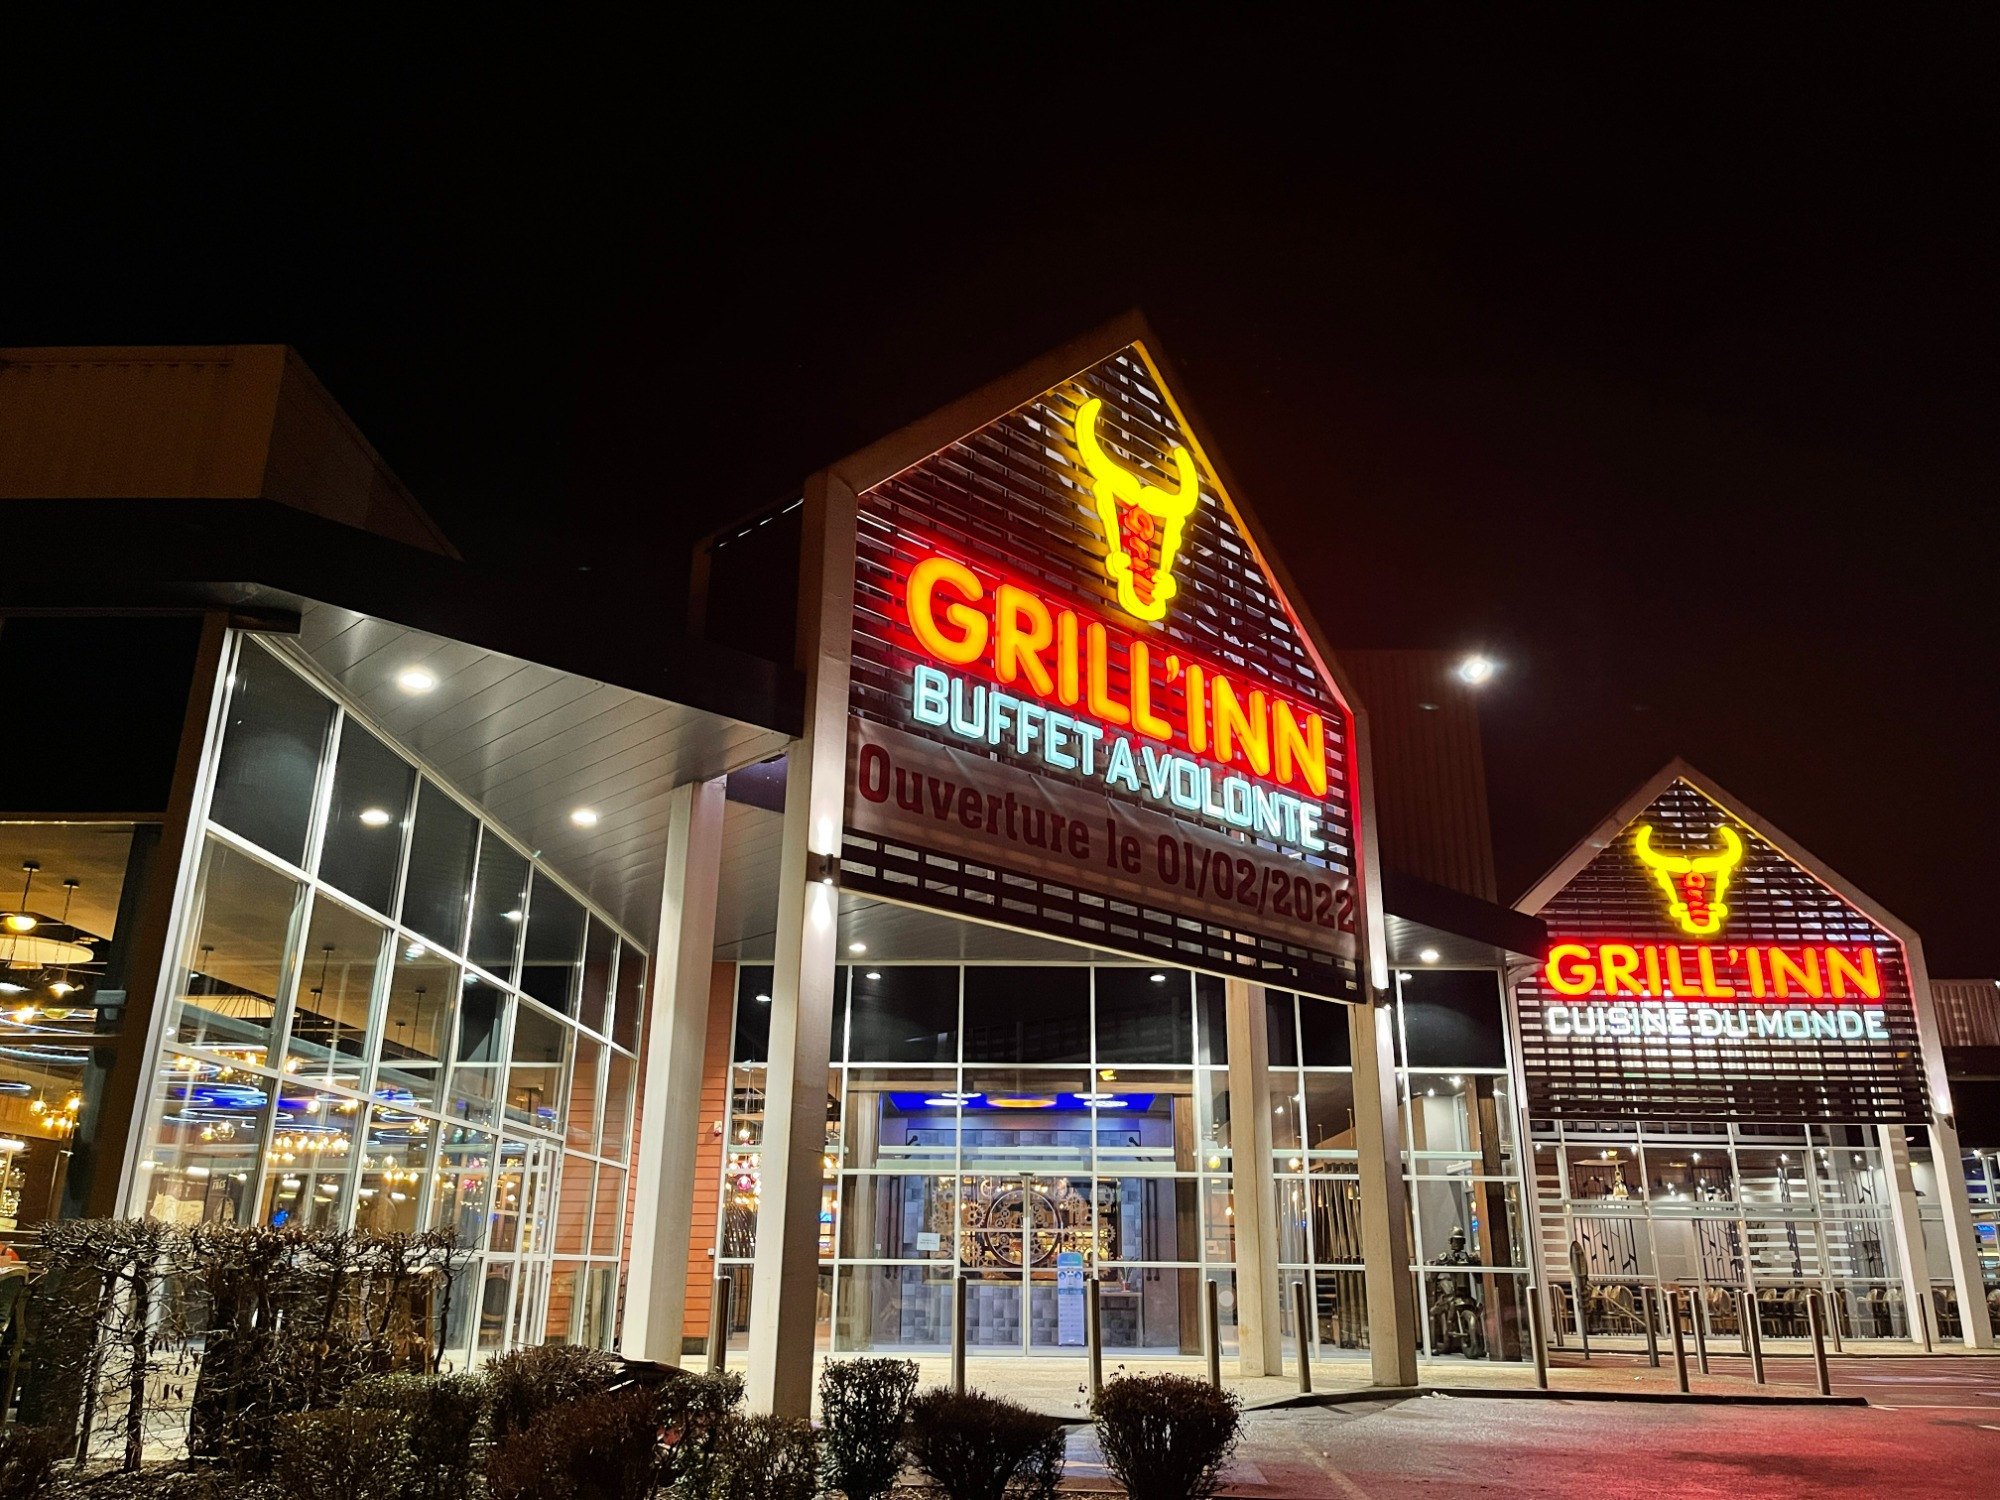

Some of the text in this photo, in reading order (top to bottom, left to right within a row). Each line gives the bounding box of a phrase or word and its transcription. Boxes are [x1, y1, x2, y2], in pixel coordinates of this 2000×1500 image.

[906, 557, 1327, 796] GRILL'INN
[913, 664, 1326, 852] BUFFET A VOLONTE
[859, 743, 1356, 934] Ouverture le 01/02/2022
[1545, 944, 1881, 999] GRILL'INN
[1548, 1006, 1889, 1039] CUISINE DU MONDE
